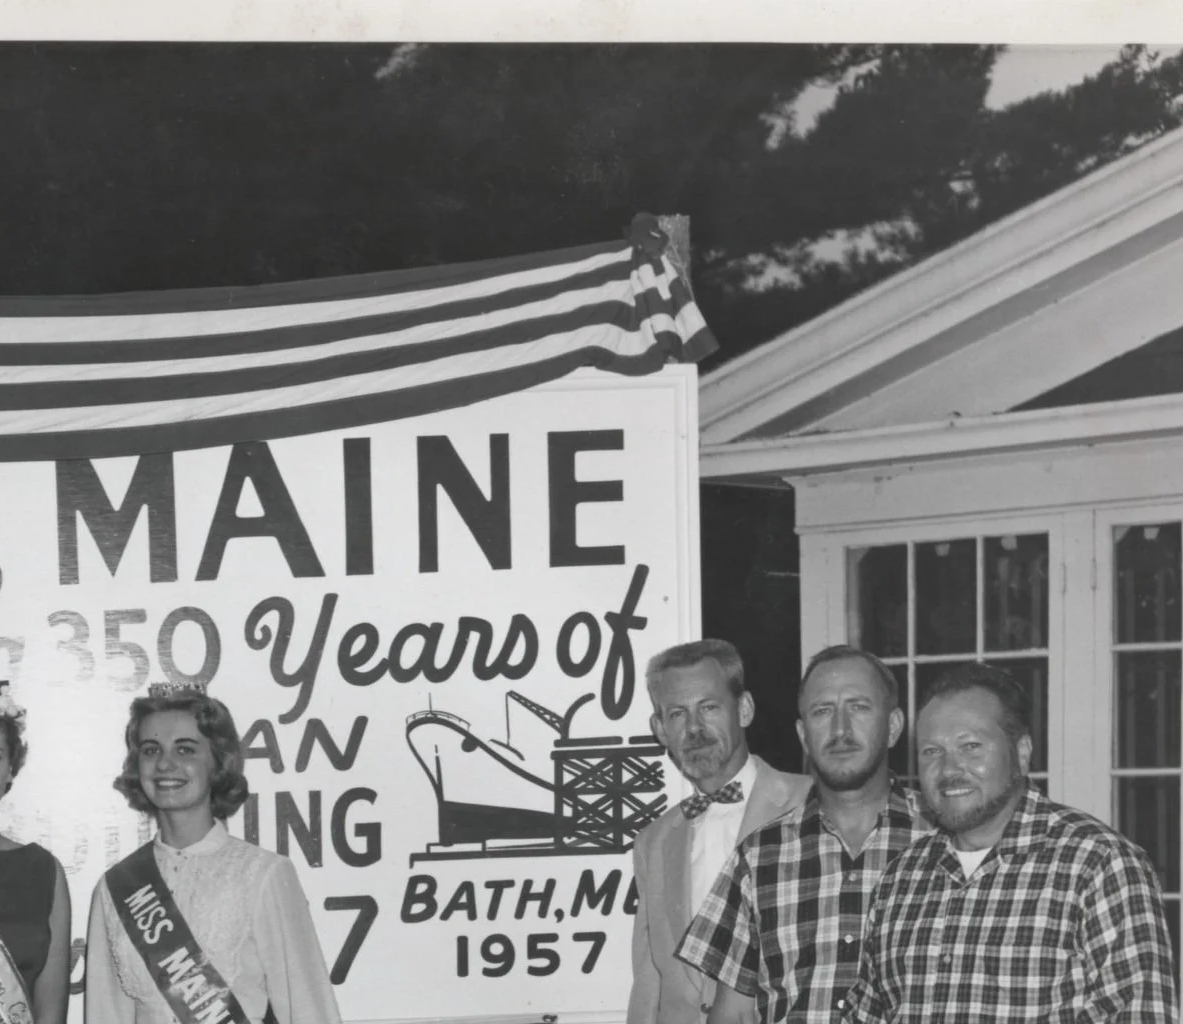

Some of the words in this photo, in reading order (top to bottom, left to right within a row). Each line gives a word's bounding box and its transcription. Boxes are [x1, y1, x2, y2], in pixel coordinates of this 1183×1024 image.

[55, 429, 625, 586] MAINE
[46, 606, 221, 694] 350
[244, 592, 539, 724] Years
[556, 563, 649, 721] of
[124, 883, 175, 945] MISS
[400, 874, 564, 924] BATH,
[456, 931, 607, 978] 1957
